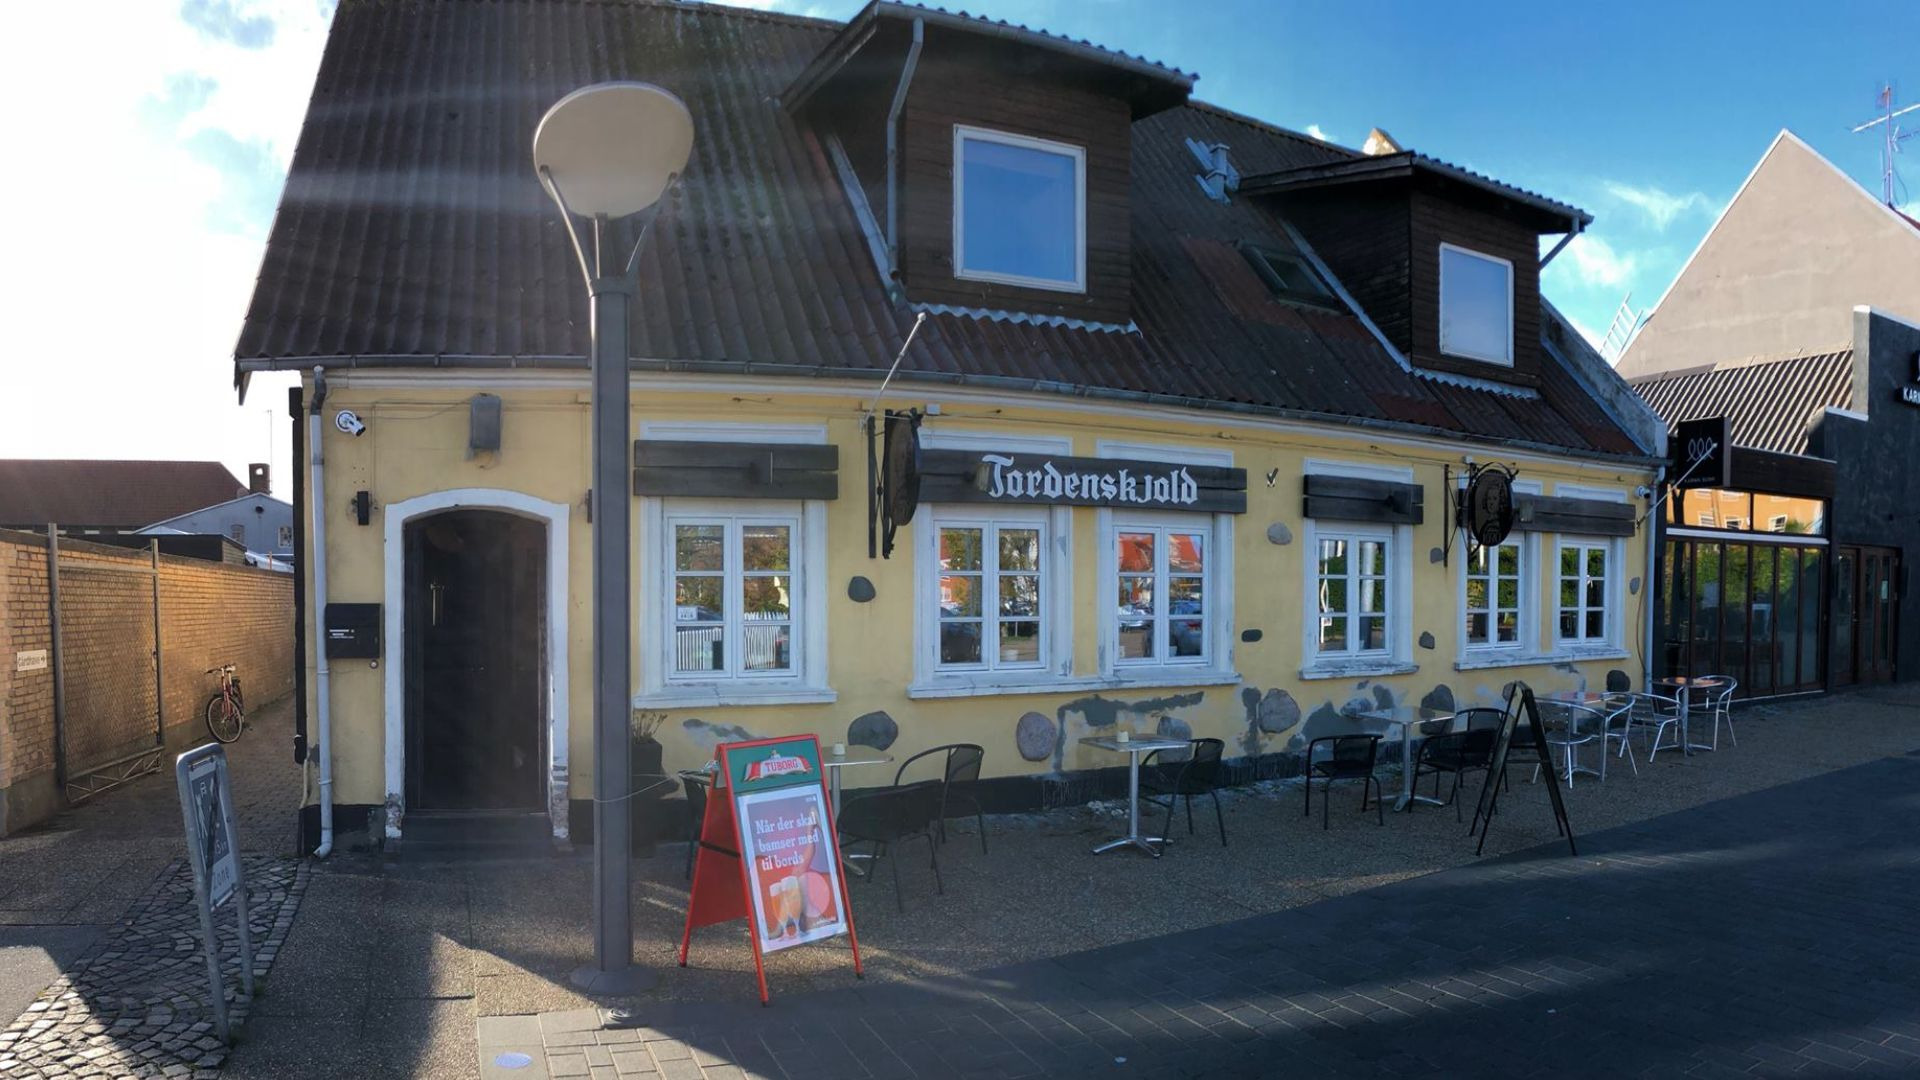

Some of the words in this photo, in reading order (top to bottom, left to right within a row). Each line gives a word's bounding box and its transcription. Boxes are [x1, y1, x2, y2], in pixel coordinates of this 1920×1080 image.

[982, 454, 1198, 505] Tordenskjold
[764, 759, 799, 772] TUBORG
[754, 819, 776, 834] Når
[777, 816, 795, 831] der
[796, 811, 817, 828] skal
[758, 838, 796, 853] bamser
[798, 828, 819, 845] med
[761, 855, 774, 871] til
[774, 851, 804, 868] bords
